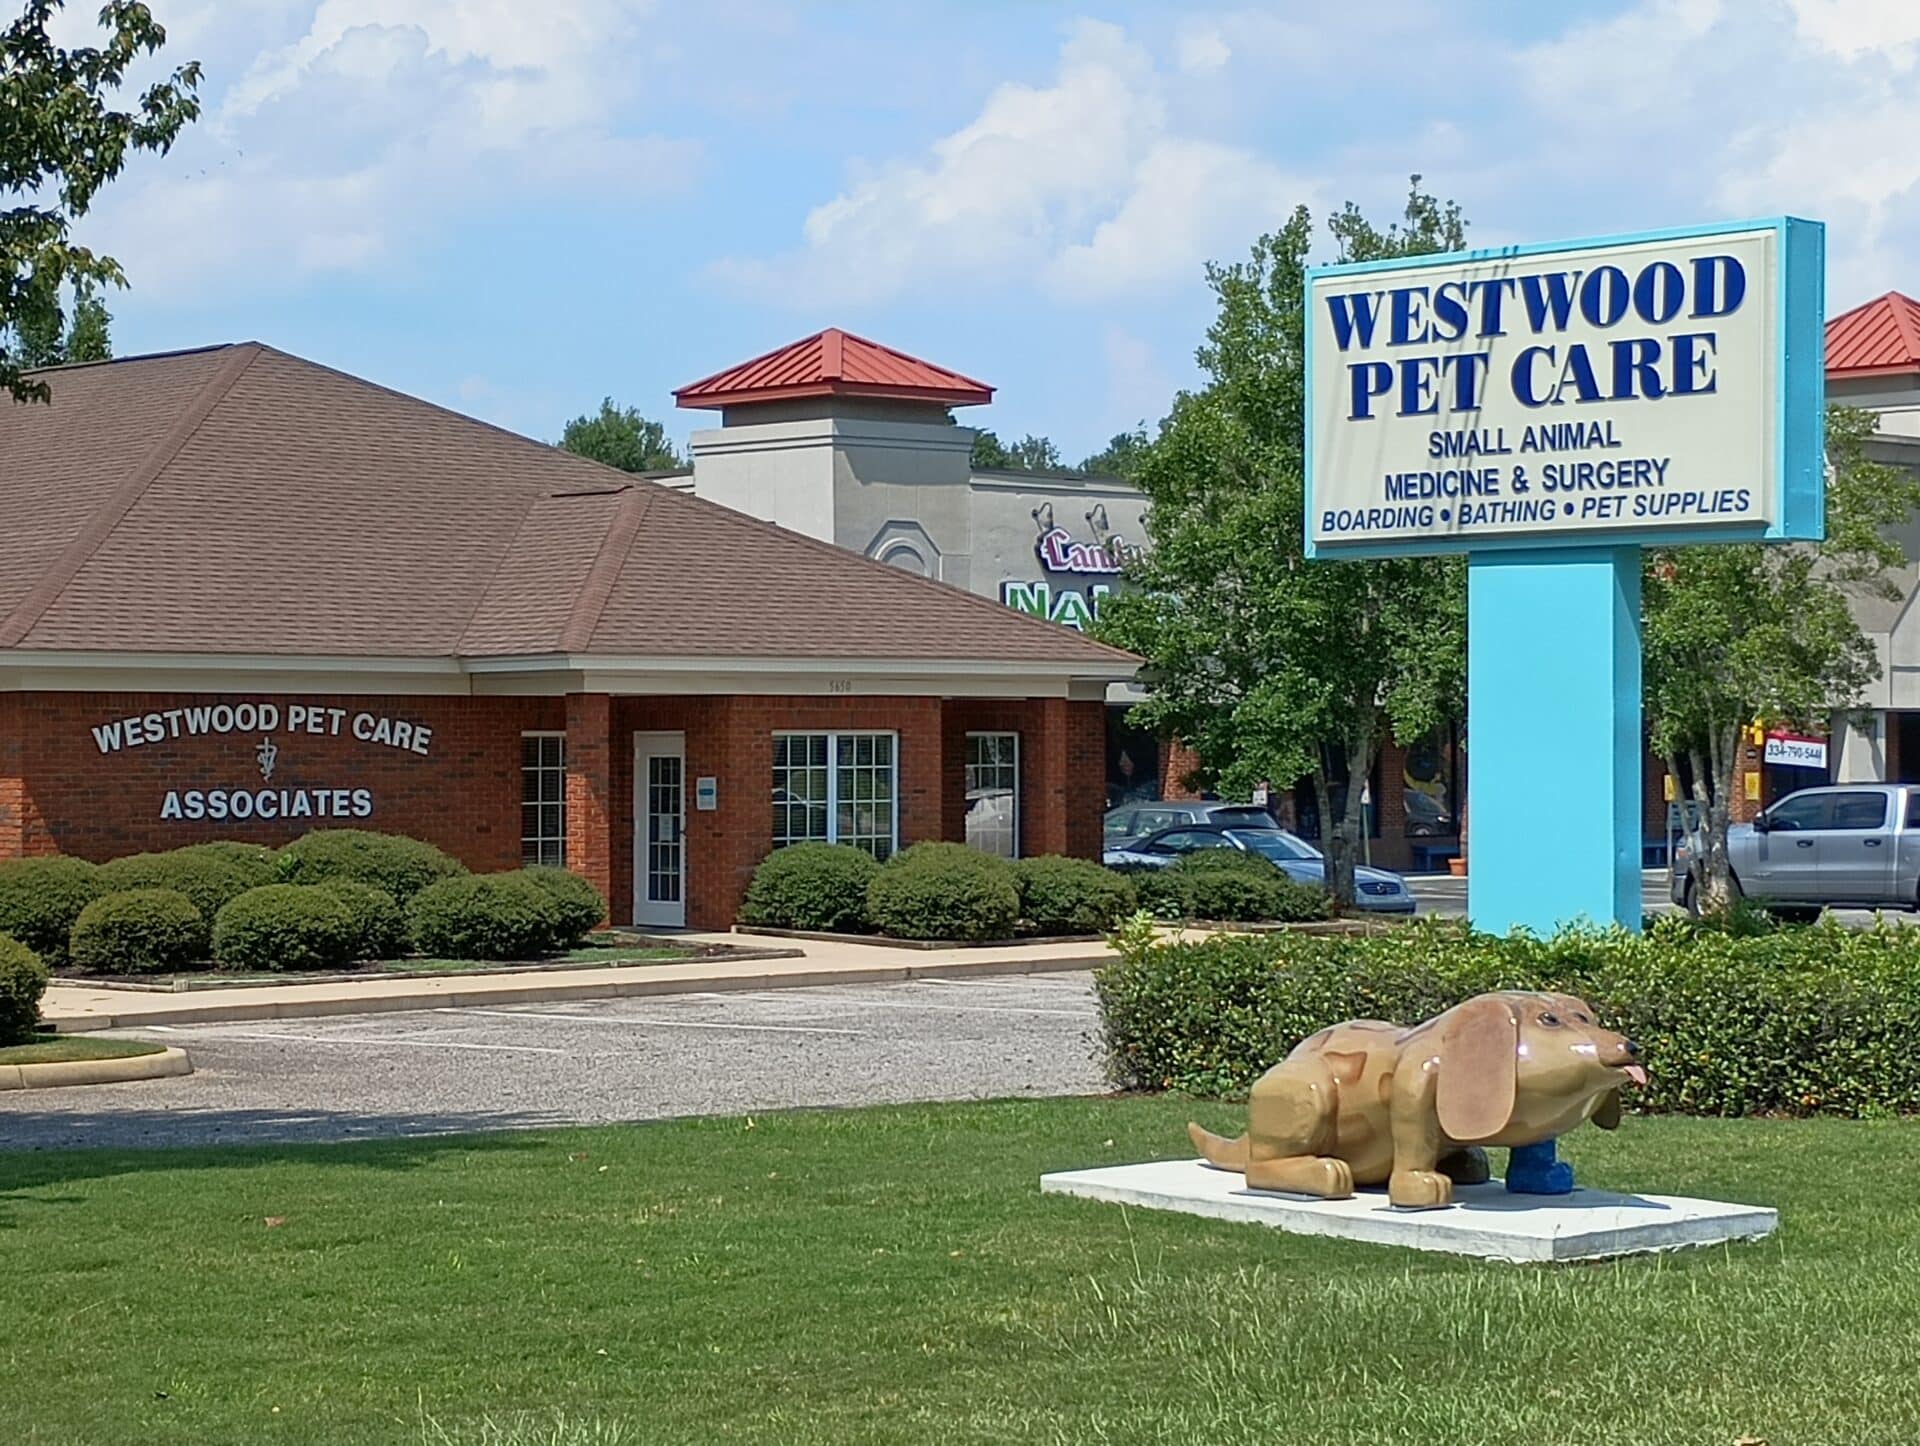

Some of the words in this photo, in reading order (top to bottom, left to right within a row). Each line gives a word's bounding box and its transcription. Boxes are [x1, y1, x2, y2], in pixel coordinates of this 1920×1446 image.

[1326, 256, 1745, 351] WESTWOOD
[1348, 353, 1489, 421] PET
[1511, 333, 1716, 407] CARE
[1429, 428, 1511, 458] SMALL
[1520, 421, 1621, 452] ANIMAL
[1386, 469, 1499, 500] MEDICINE
[1512, 466, 1529, 494] &
[1543, 458, 1669, 492] SURGERY
[1322, 506, 1433, 531] BOARDING
[1458, 500, 1555, 525] BATHING
[1582, 496, 1627, 518] PET
[1633, 490, 1749, 516] SUPPLIES
[92, 704, 278, 752] WESTWOOD
[289, 706, 345, 734] PET
[354, 714, 432, 754] CARE
[161, 790, 372, 818] ASSOCIATES
